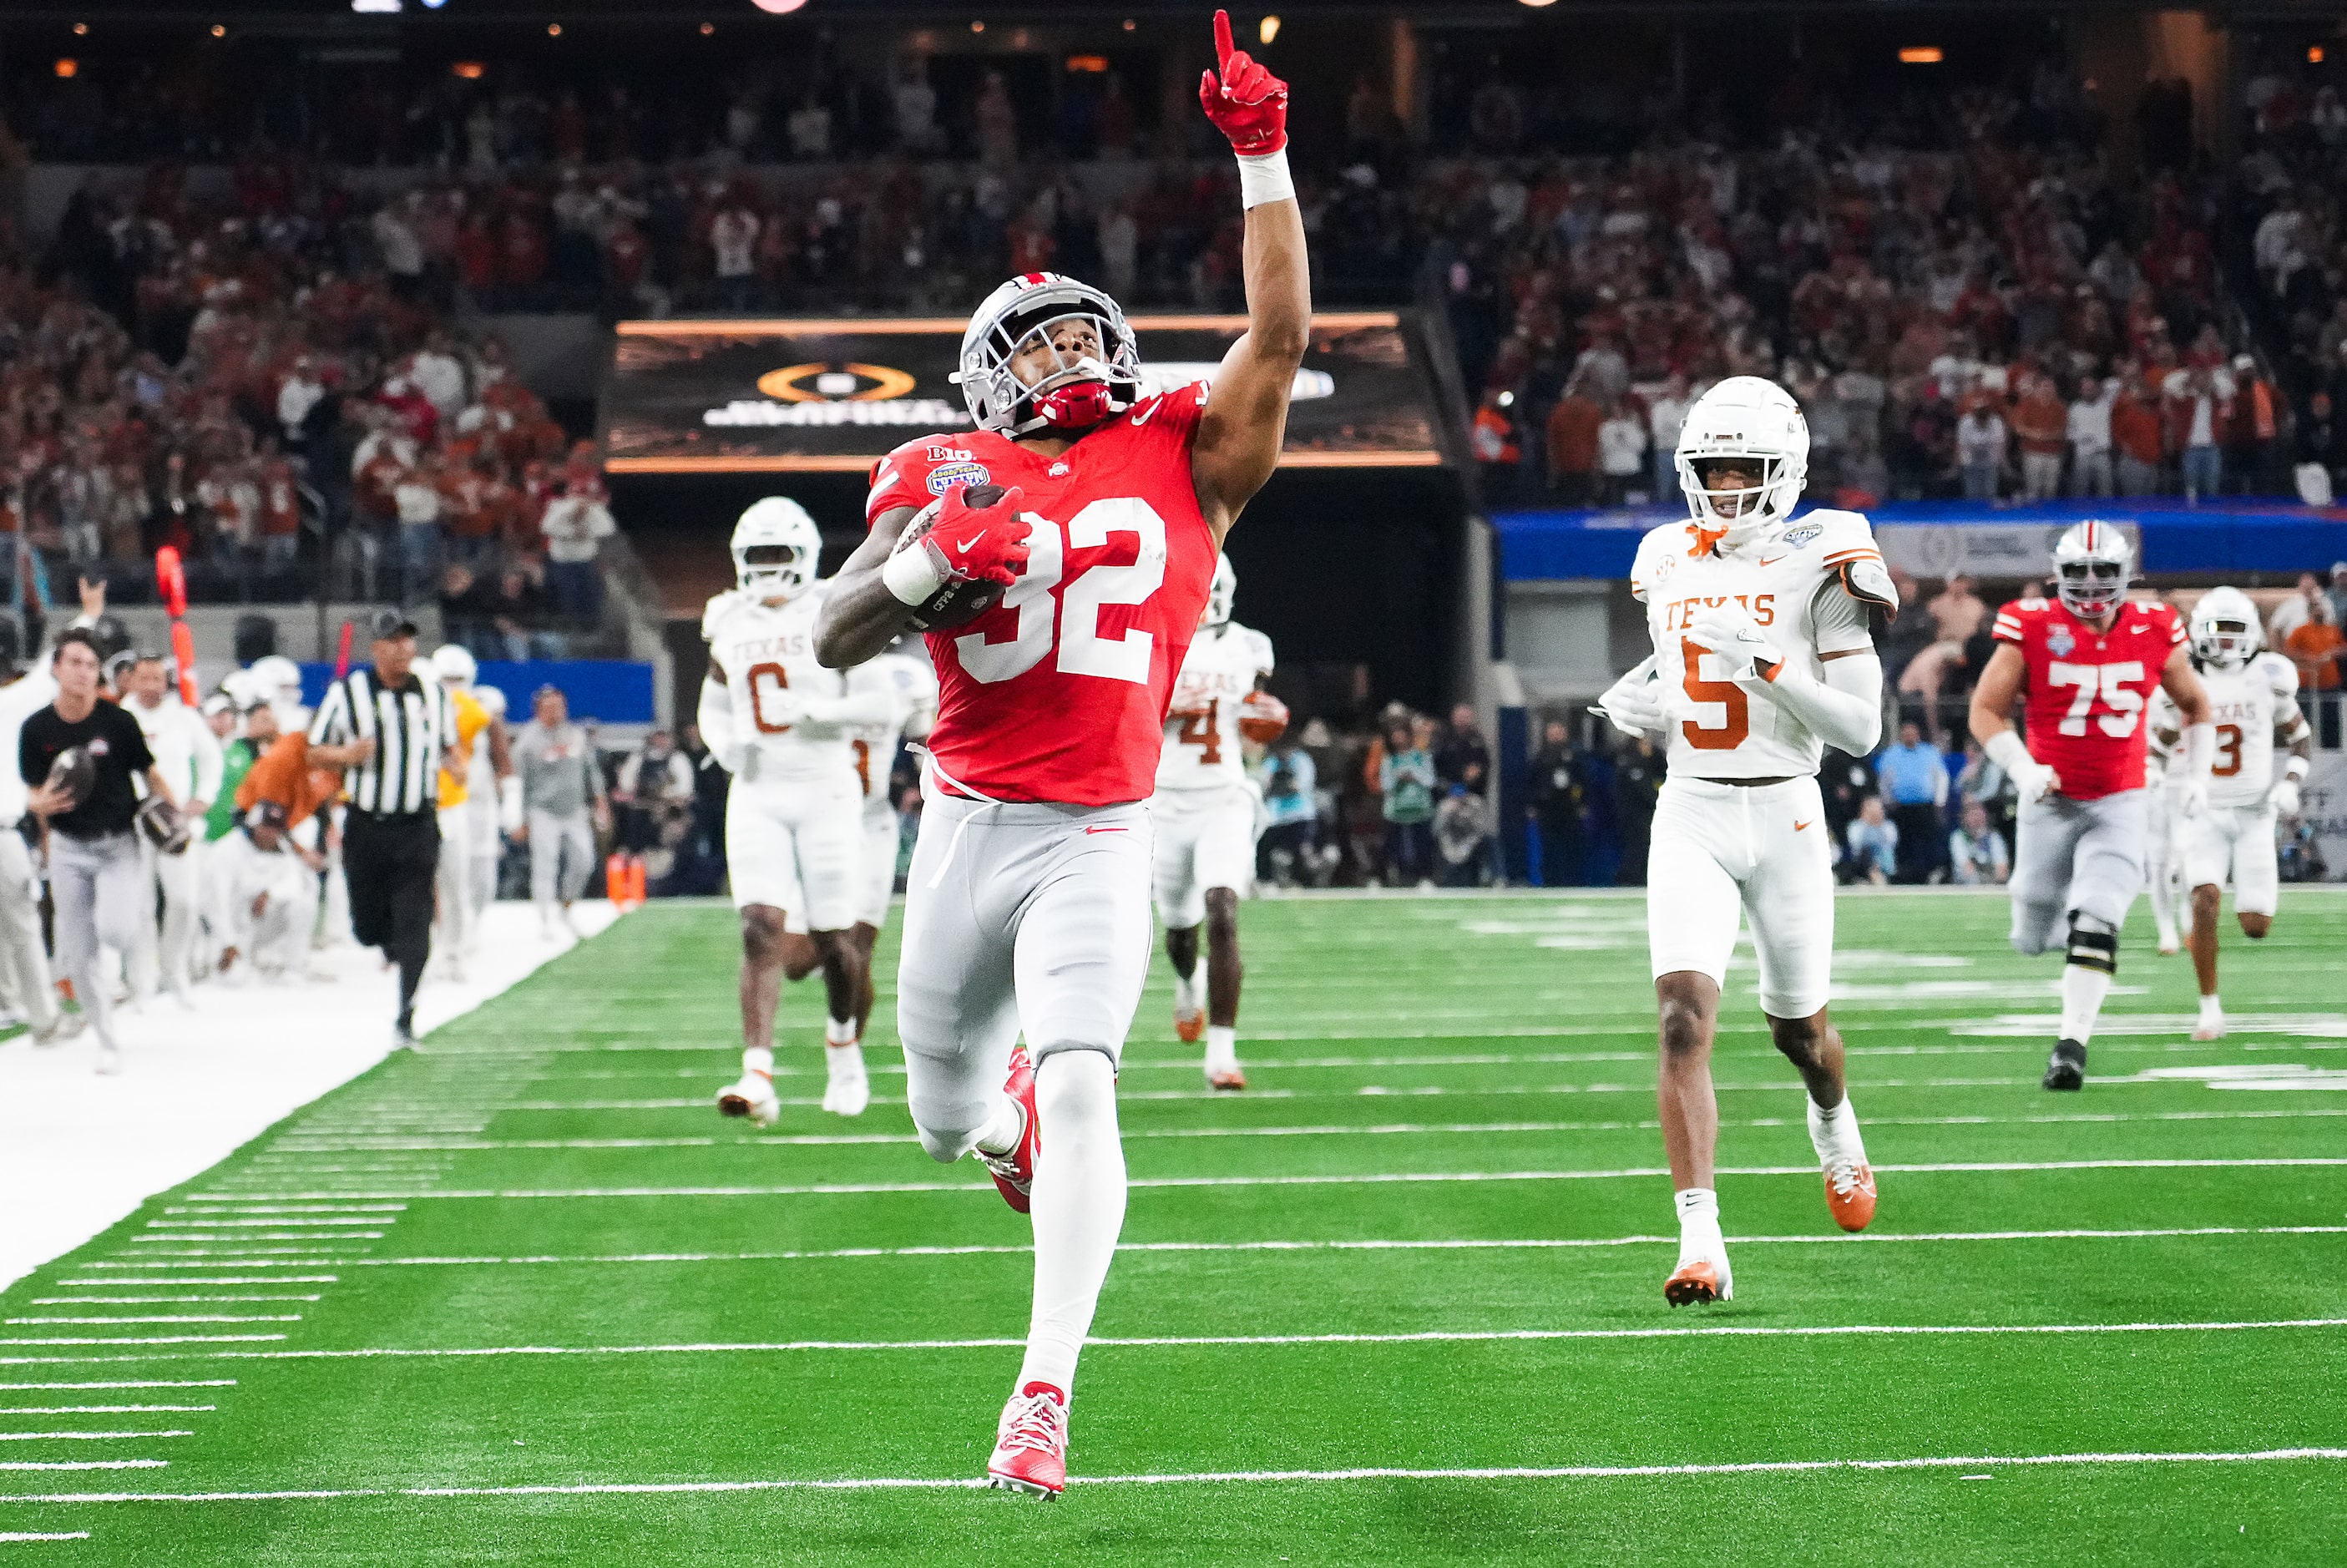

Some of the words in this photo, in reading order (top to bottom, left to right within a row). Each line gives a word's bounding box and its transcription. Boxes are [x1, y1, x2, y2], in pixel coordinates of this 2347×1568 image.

[954, 497, 1166, 685] 32
[732, 635, 804, 661] TEXAS
[1681, 635, 1749, 750] 5
[2048, 660, 2145, 738] 75
[2211, 724, 2243, 777] 3
